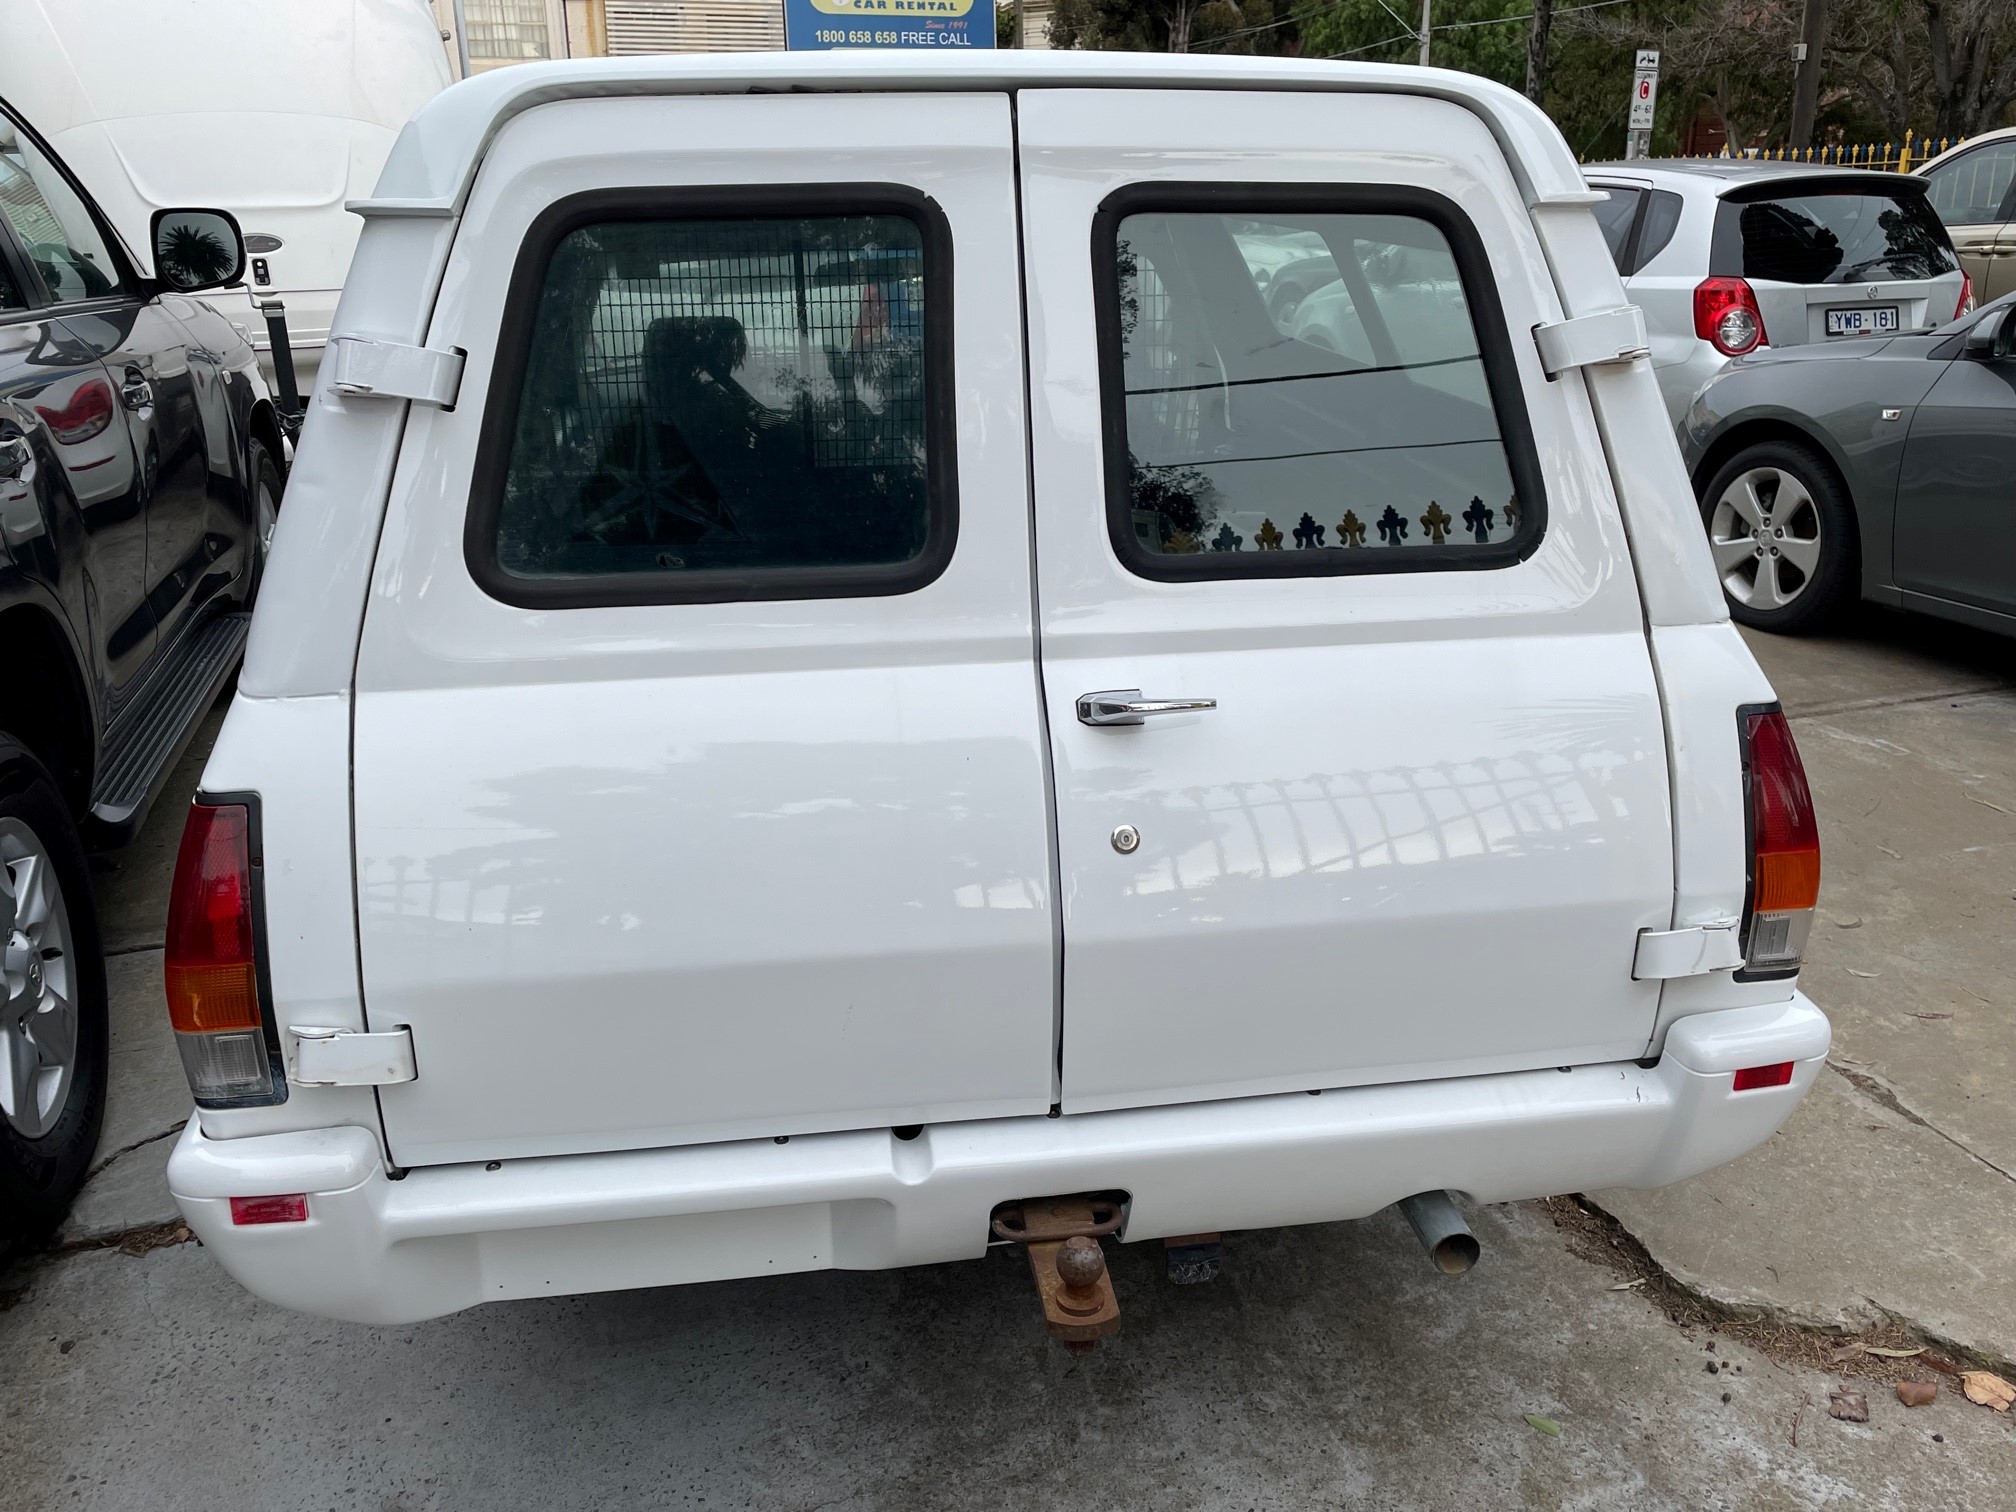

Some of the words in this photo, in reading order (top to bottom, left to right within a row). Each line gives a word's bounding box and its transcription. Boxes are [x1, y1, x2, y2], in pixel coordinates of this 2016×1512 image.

[854, 0, 887, 9] CAR
[895, 0, 957, 11] RENTAL
[925, 20, 945, 29] Since
[948, 21, 968, 29] 1991
[815, 30, 845, 43] 1800
[849, 31, 872, 44] 658
[875, 31, 898, 44] 658
[901, 32, 936, 45] FREE
[939, 32, 971, 46] CALL
